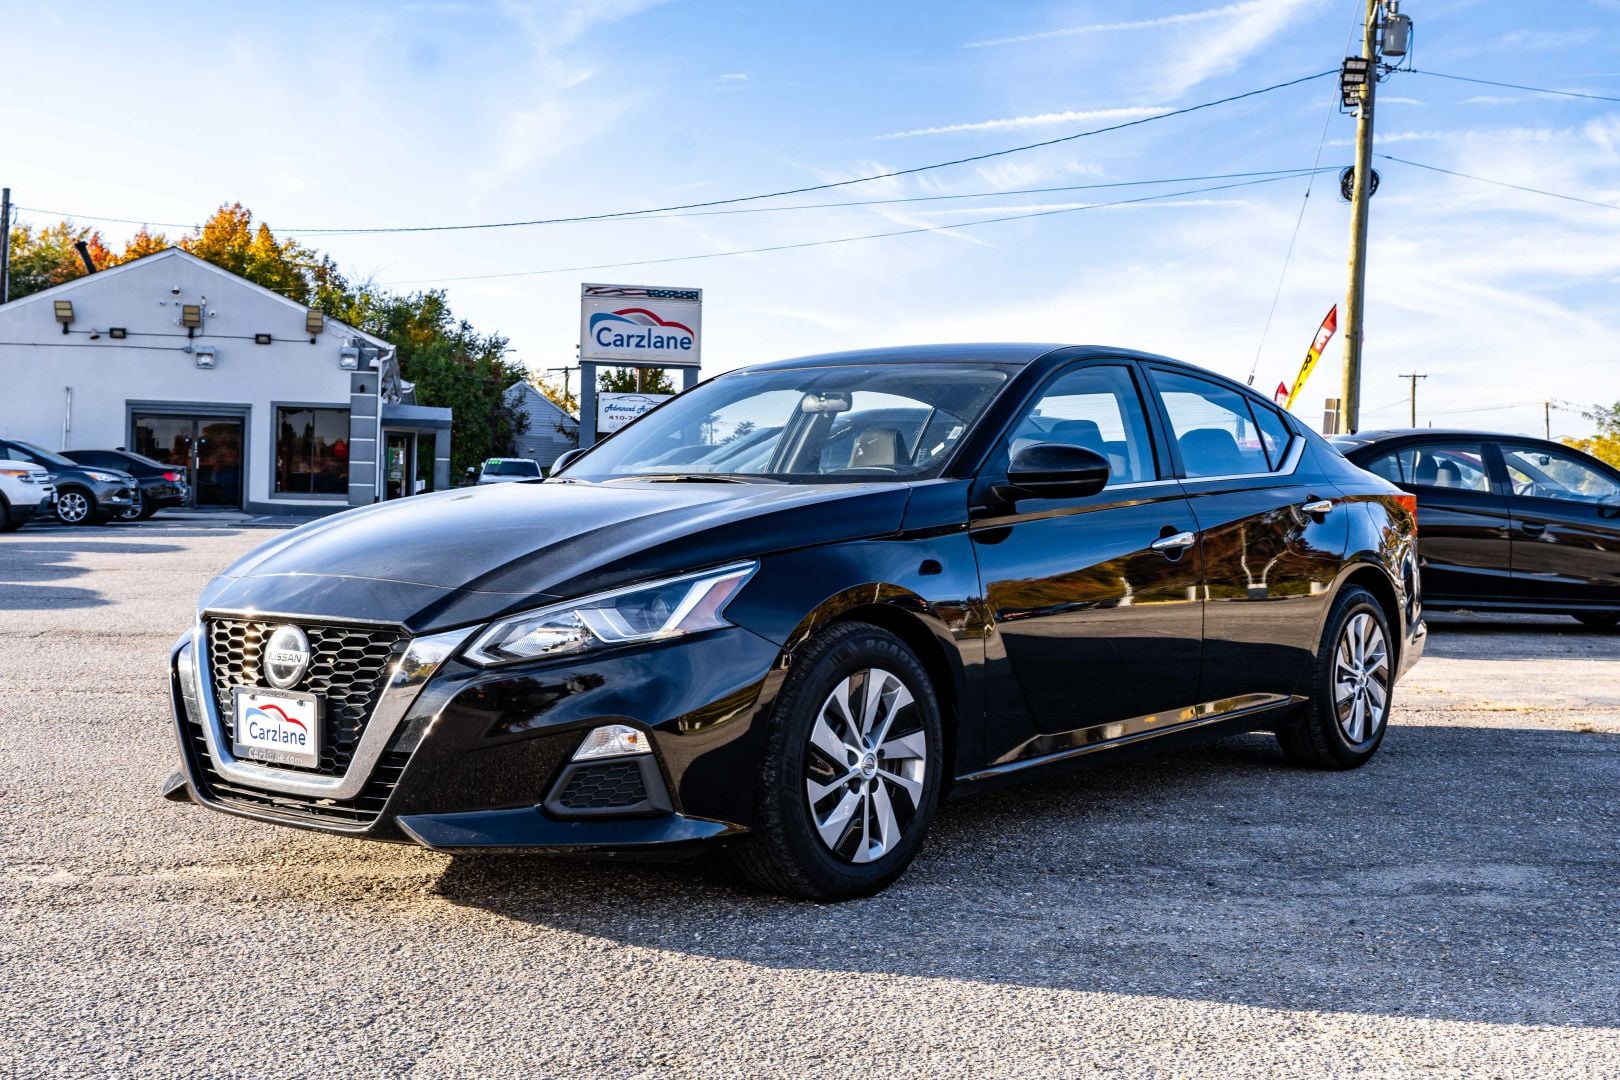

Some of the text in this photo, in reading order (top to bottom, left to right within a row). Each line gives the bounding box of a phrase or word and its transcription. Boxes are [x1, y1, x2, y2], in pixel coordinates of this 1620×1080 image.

[596, 326, 693, 350] Carzlane
[604, 404, 636, 413] Advanced
[269, 652, 302, 663] NISSAN
[249, 721, 306, 746] Carzlane
